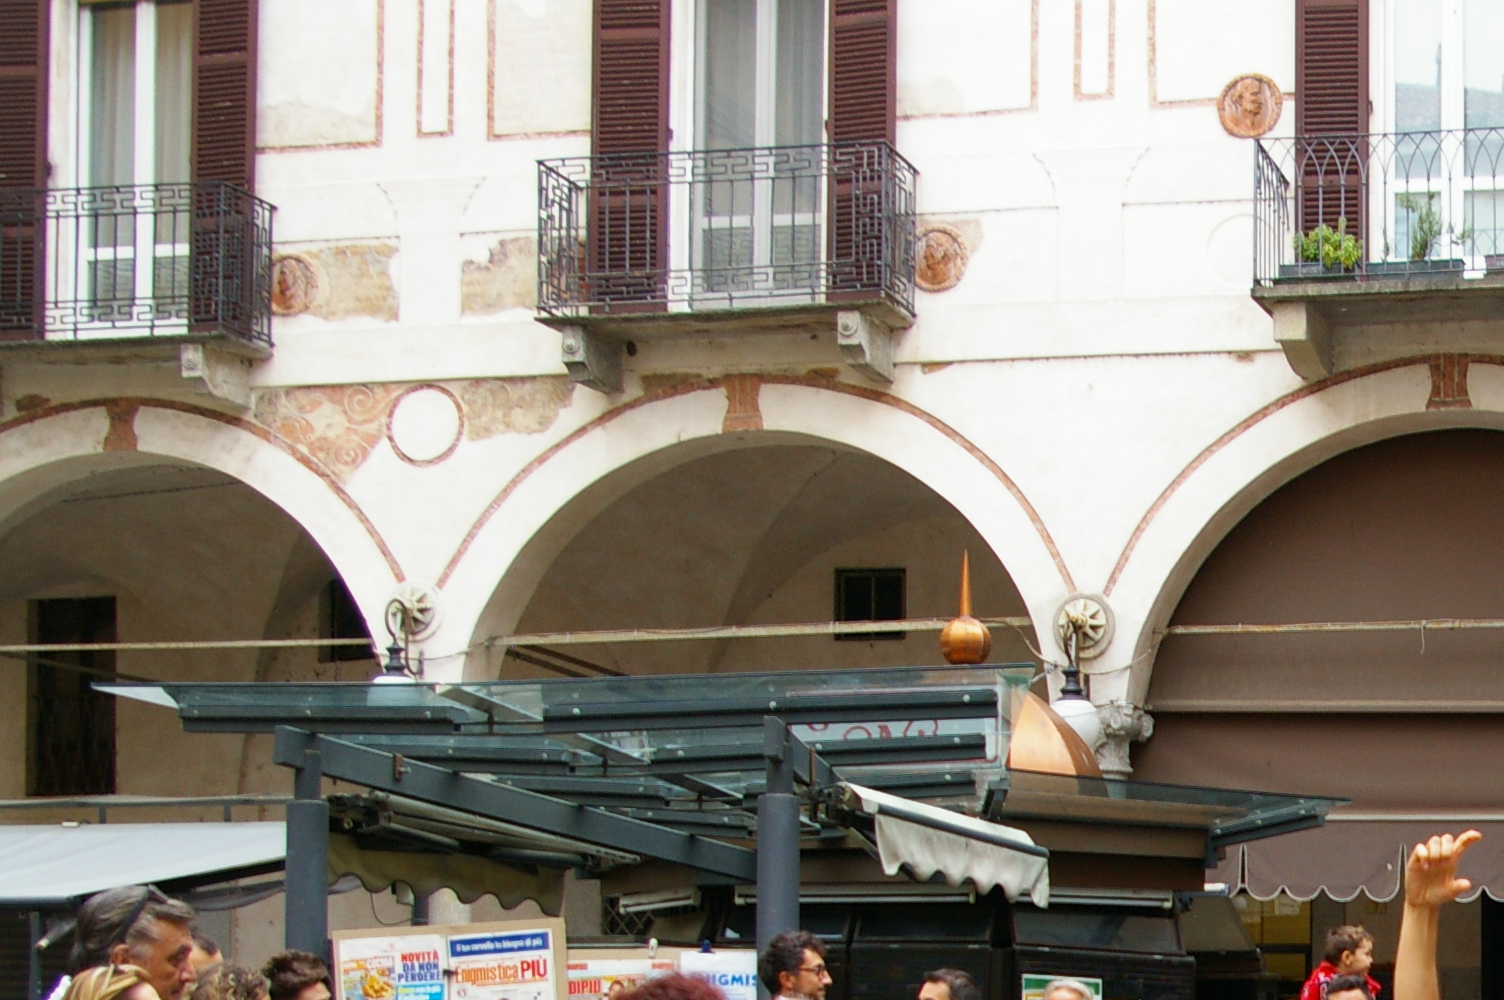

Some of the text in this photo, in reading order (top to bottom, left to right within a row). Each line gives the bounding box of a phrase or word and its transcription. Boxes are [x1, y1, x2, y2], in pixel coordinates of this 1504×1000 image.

[401, 949, 439, 962] NOVITÀ
[402, 961, 439, 973] DA NON
[455, 955, 548, 985] Enigmistica PIÙ
